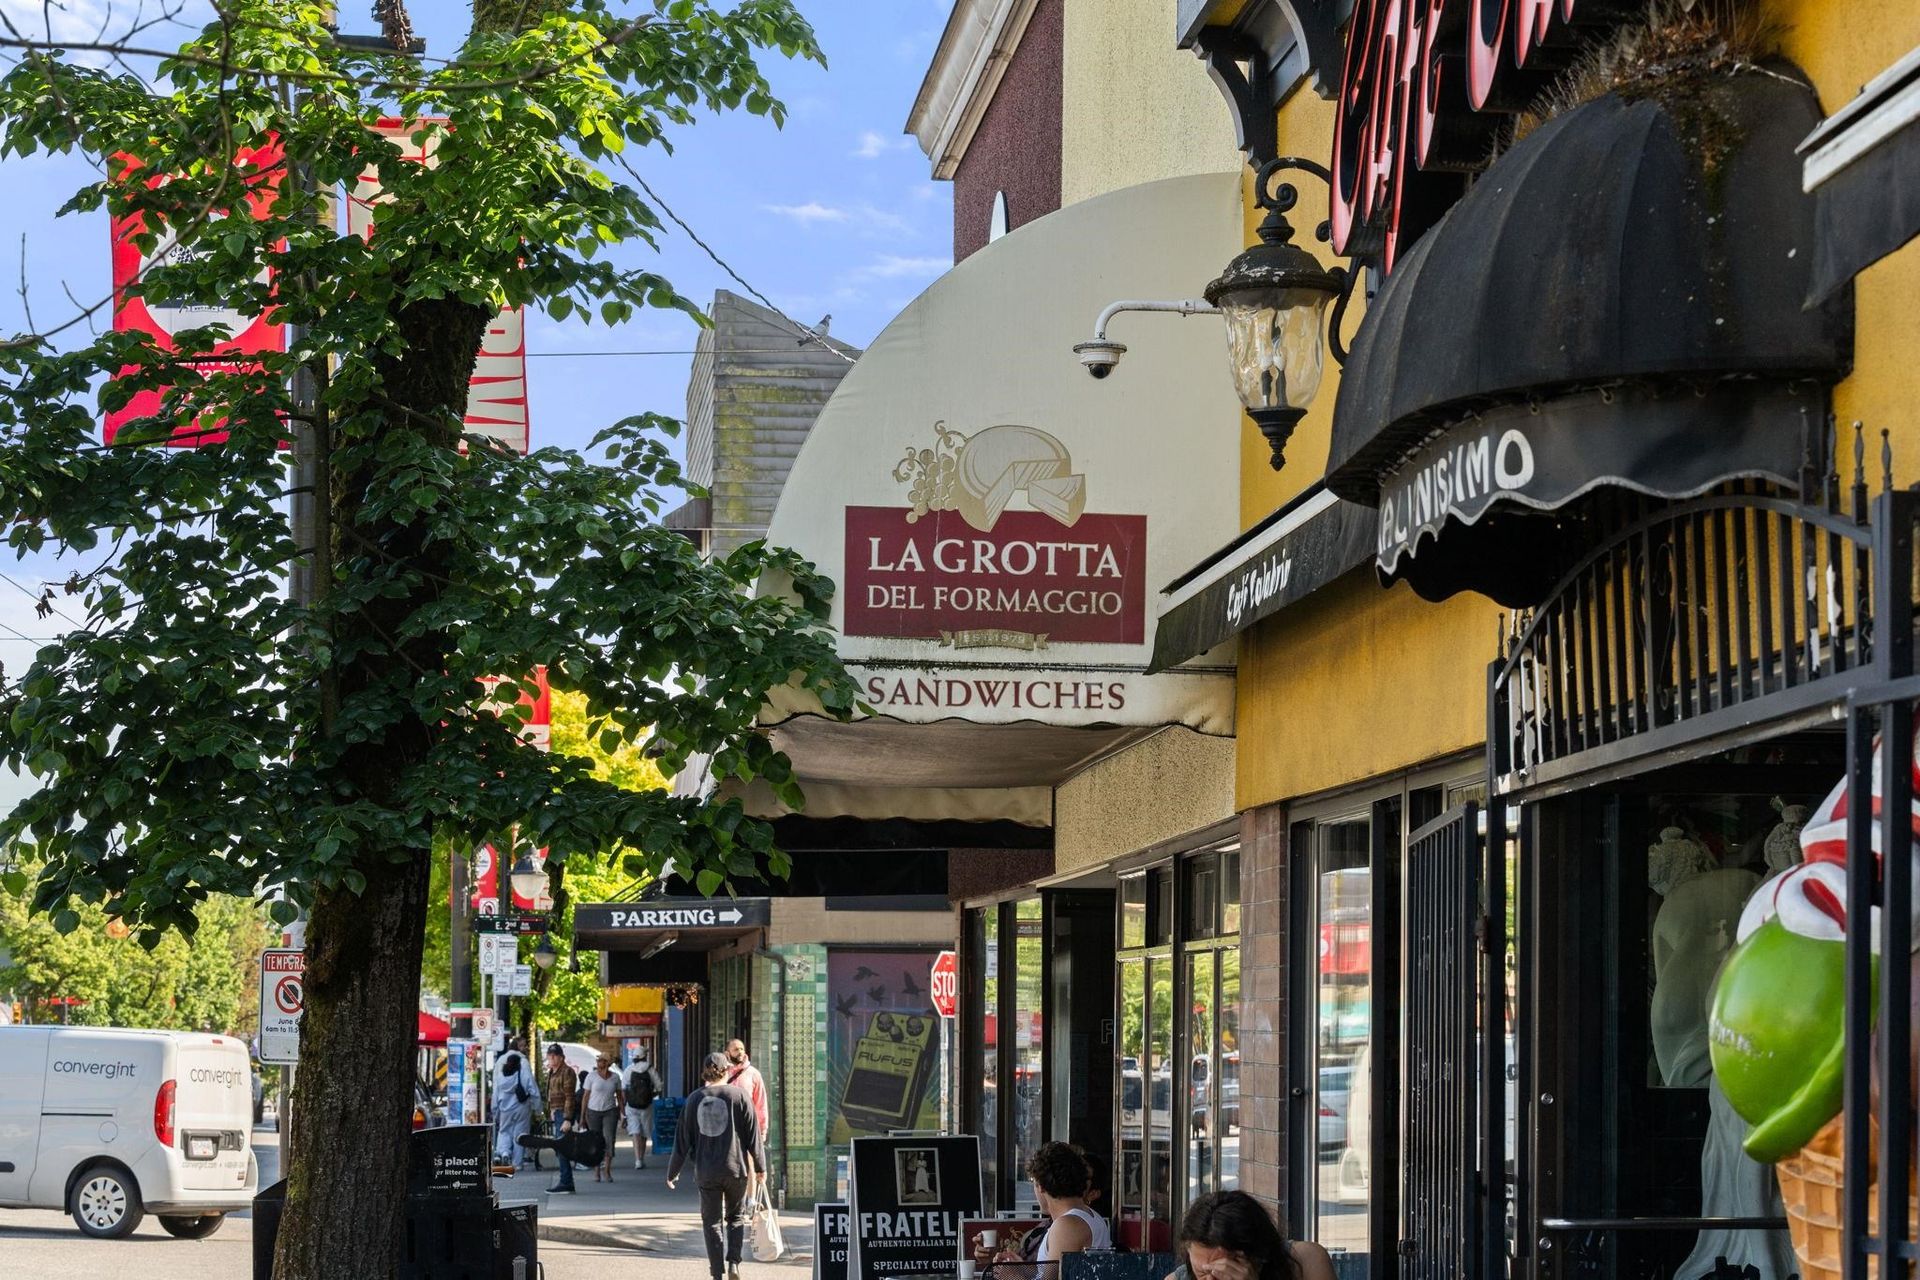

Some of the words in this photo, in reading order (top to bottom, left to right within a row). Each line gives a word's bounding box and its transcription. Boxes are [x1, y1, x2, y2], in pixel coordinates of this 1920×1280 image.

[868, 537, 925, 572] LA
[933, 538, 1122, 578] GROTTA
[867, 585, 925, 610] DEL
[934, 586, 1122, 616] FORMAGGIO
[868, 676, 1125, 710] SANDWICHES
[505, 921, 517, 930] 2nd
[610, 909, 716, 927] PARKING
[934, 971, 956, 997] STO
[858, 1051, 914, 1067] RUFUS
[54, 1060, 136, 1079] convergint
[190, 1067, 243, 1088] convergint
[445, 1157, 478, 1167] place!
[860, 1211, 980, 1238] FRATEL
[868, 1239, 912, 1248] AUTHENTIC
[912, 1239, 944, 1247] ITALIAN
[946, 1239, 958, 1247] BA
[873, 1260, 929, 1270] SPECIALTY
